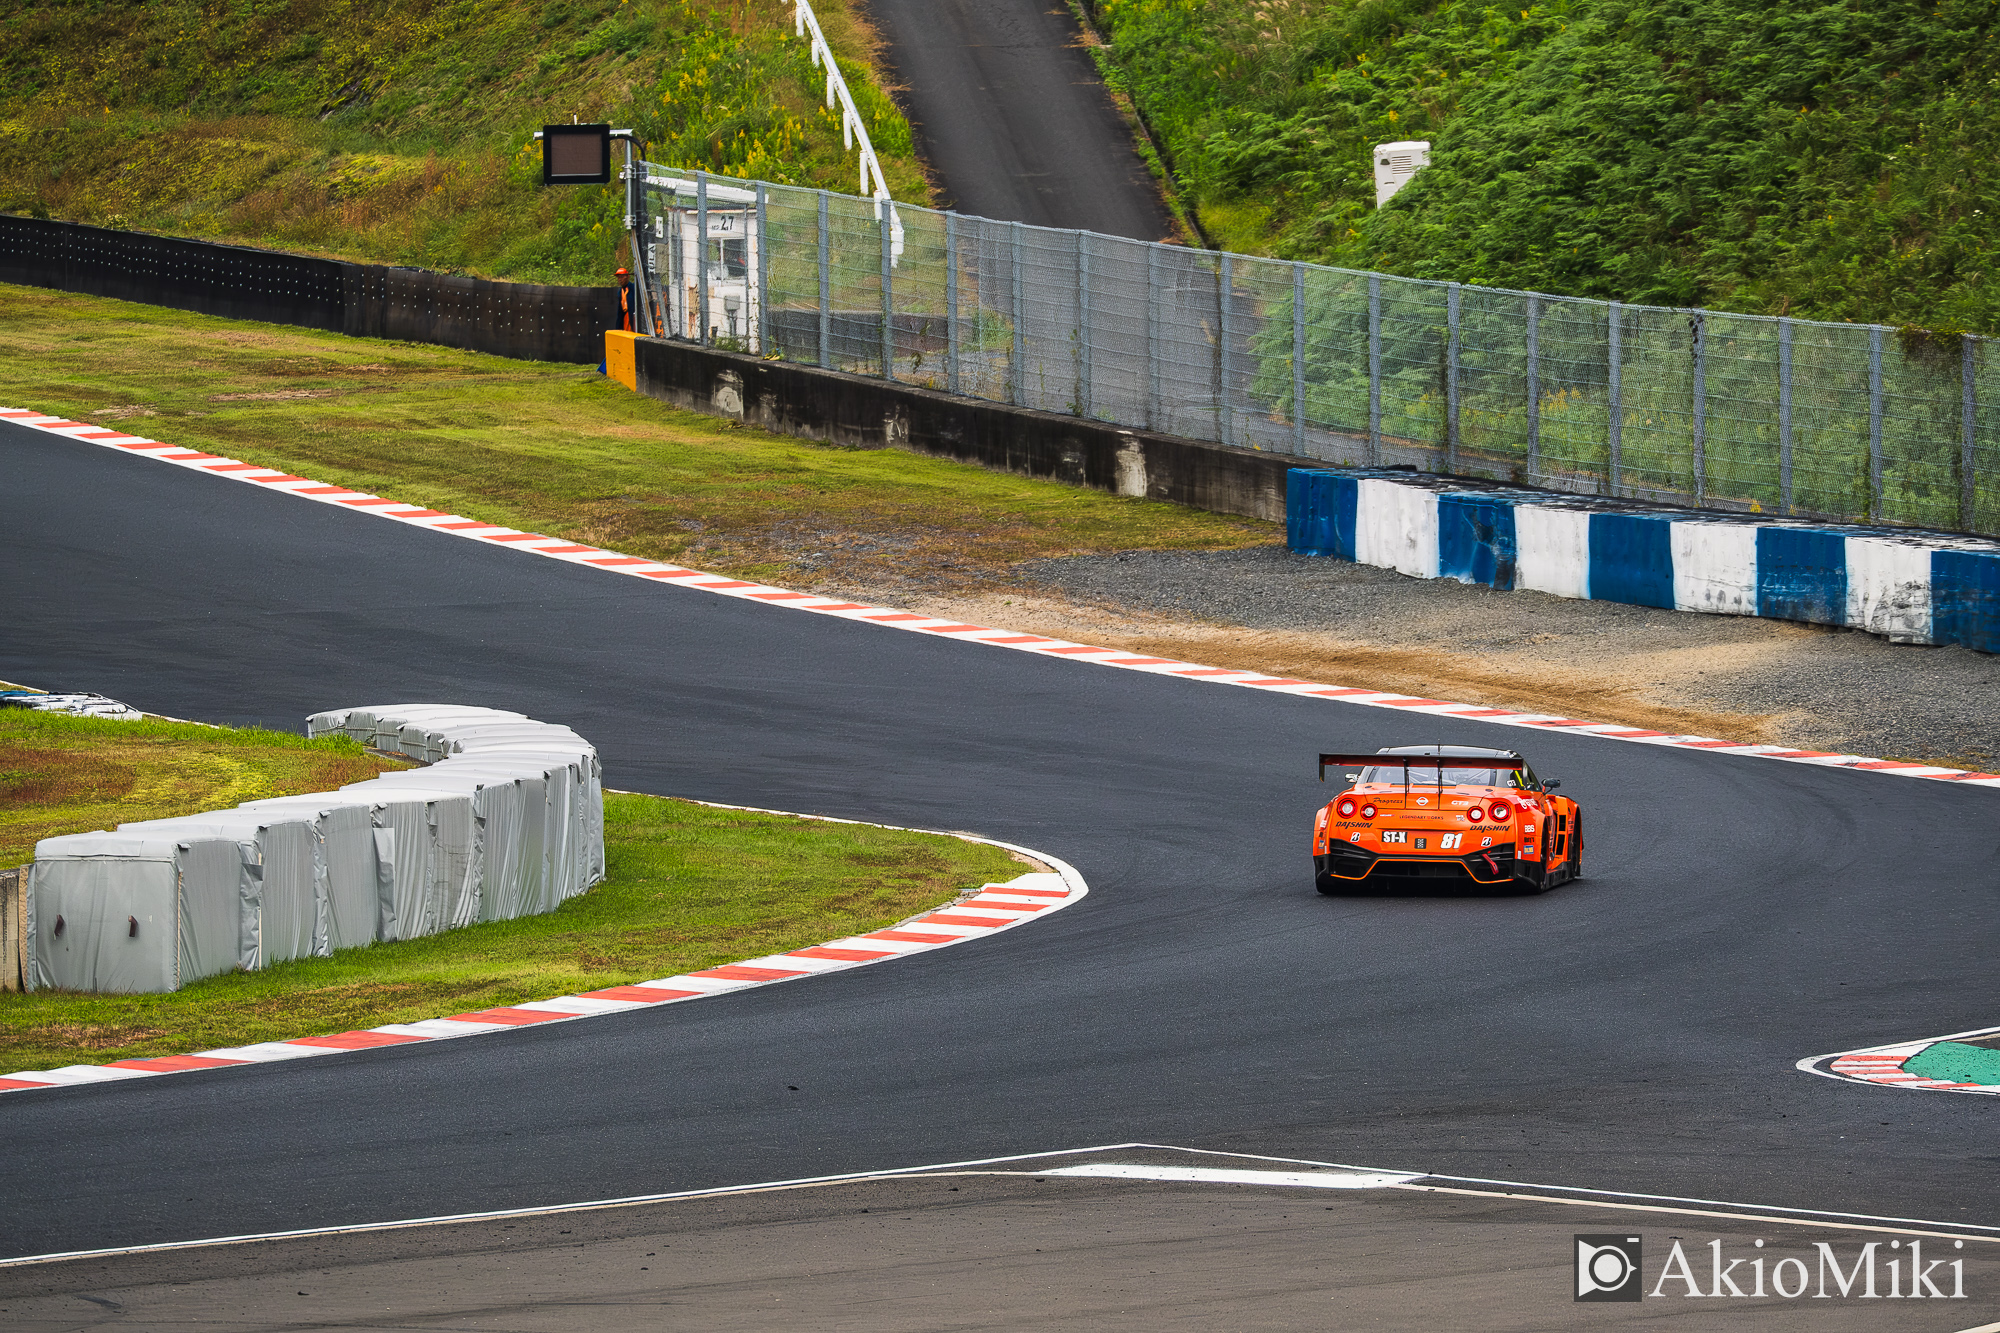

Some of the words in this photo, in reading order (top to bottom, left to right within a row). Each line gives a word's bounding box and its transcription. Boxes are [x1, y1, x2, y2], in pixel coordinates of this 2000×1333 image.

[720, 215, 734, 231] 27
[1383, 831, 1406, 843] ST-X
[1440, 833, 1463, 849] 81
